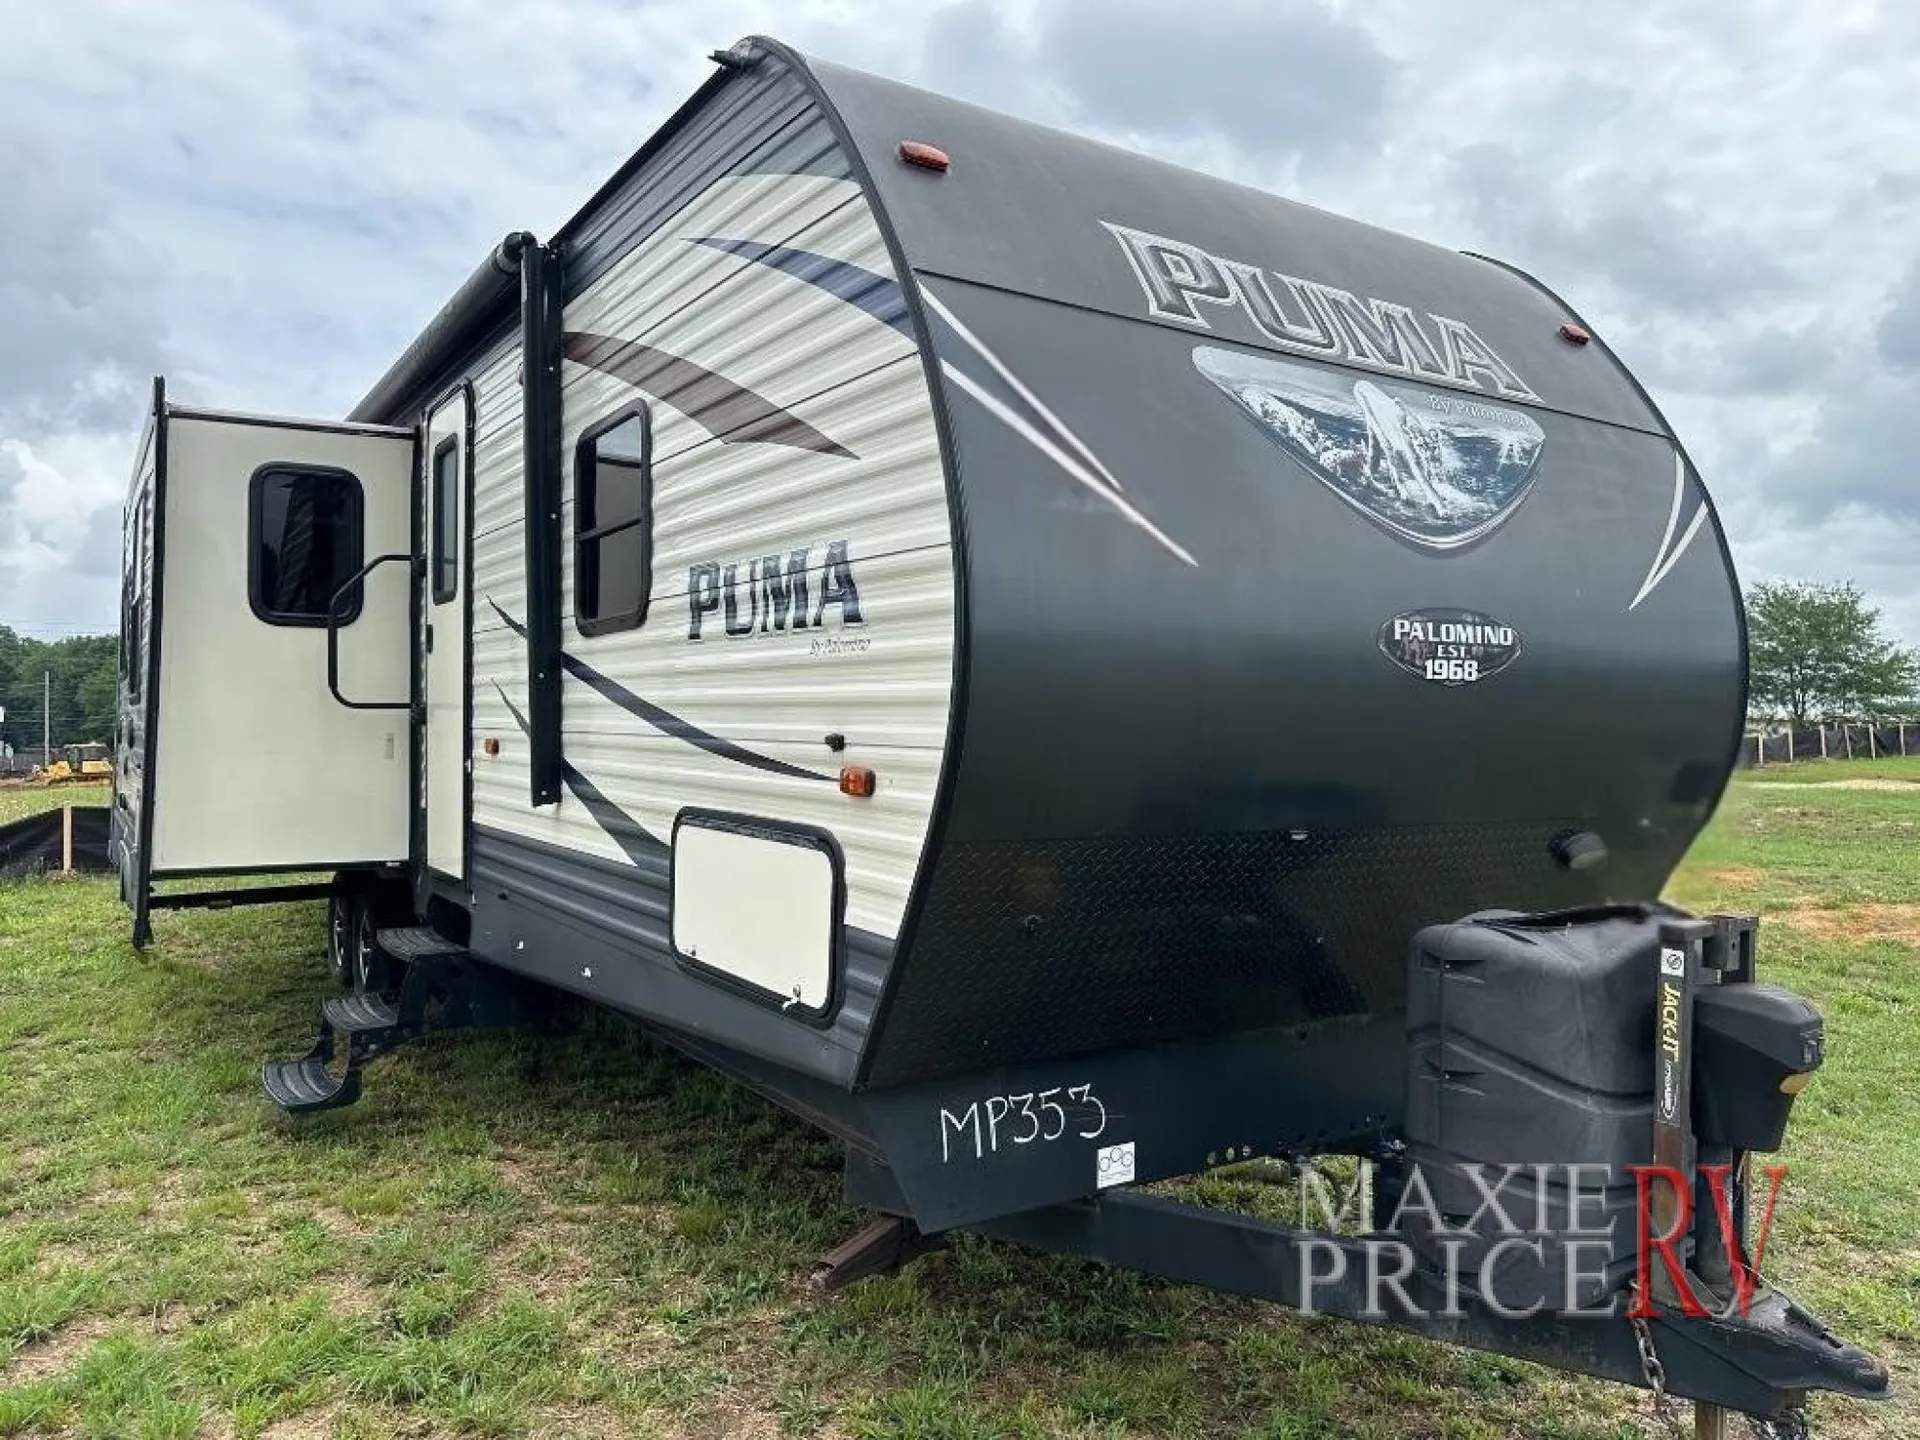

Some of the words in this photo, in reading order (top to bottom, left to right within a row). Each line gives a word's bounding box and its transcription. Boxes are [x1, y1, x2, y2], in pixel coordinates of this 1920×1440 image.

[1099, 219, 1545, 403] PUMA
[687, 539, 866, 643] PUMA
[1394, 619, 1513, 646] PALOMINO
[1424, 659, 1479, 682] 1968
[1662, 982, 1681, 1063] JACK-IT
[940, 1083, 1106, 1163] MP353
